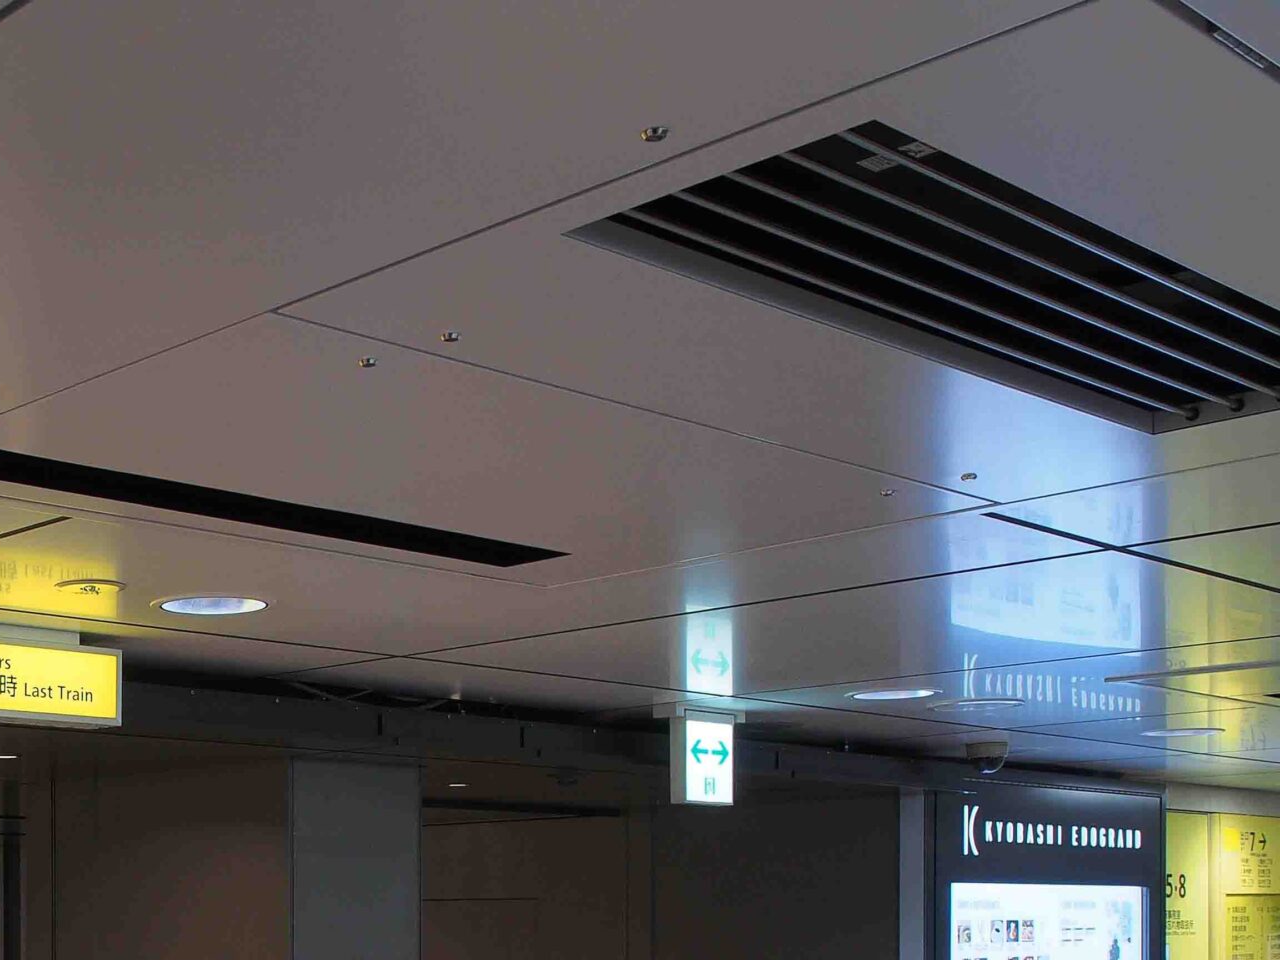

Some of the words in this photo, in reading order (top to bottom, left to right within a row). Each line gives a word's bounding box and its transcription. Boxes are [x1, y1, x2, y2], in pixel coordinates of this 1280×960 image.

[24, 682, 53, 700] Last
[57, 685, 94, 703] Train
[985, 820, 1063, 846] KYOBASHI
[1071, 825, 1142, 850] EDOGRAND
[1249, 831, 1256, 851] 7
